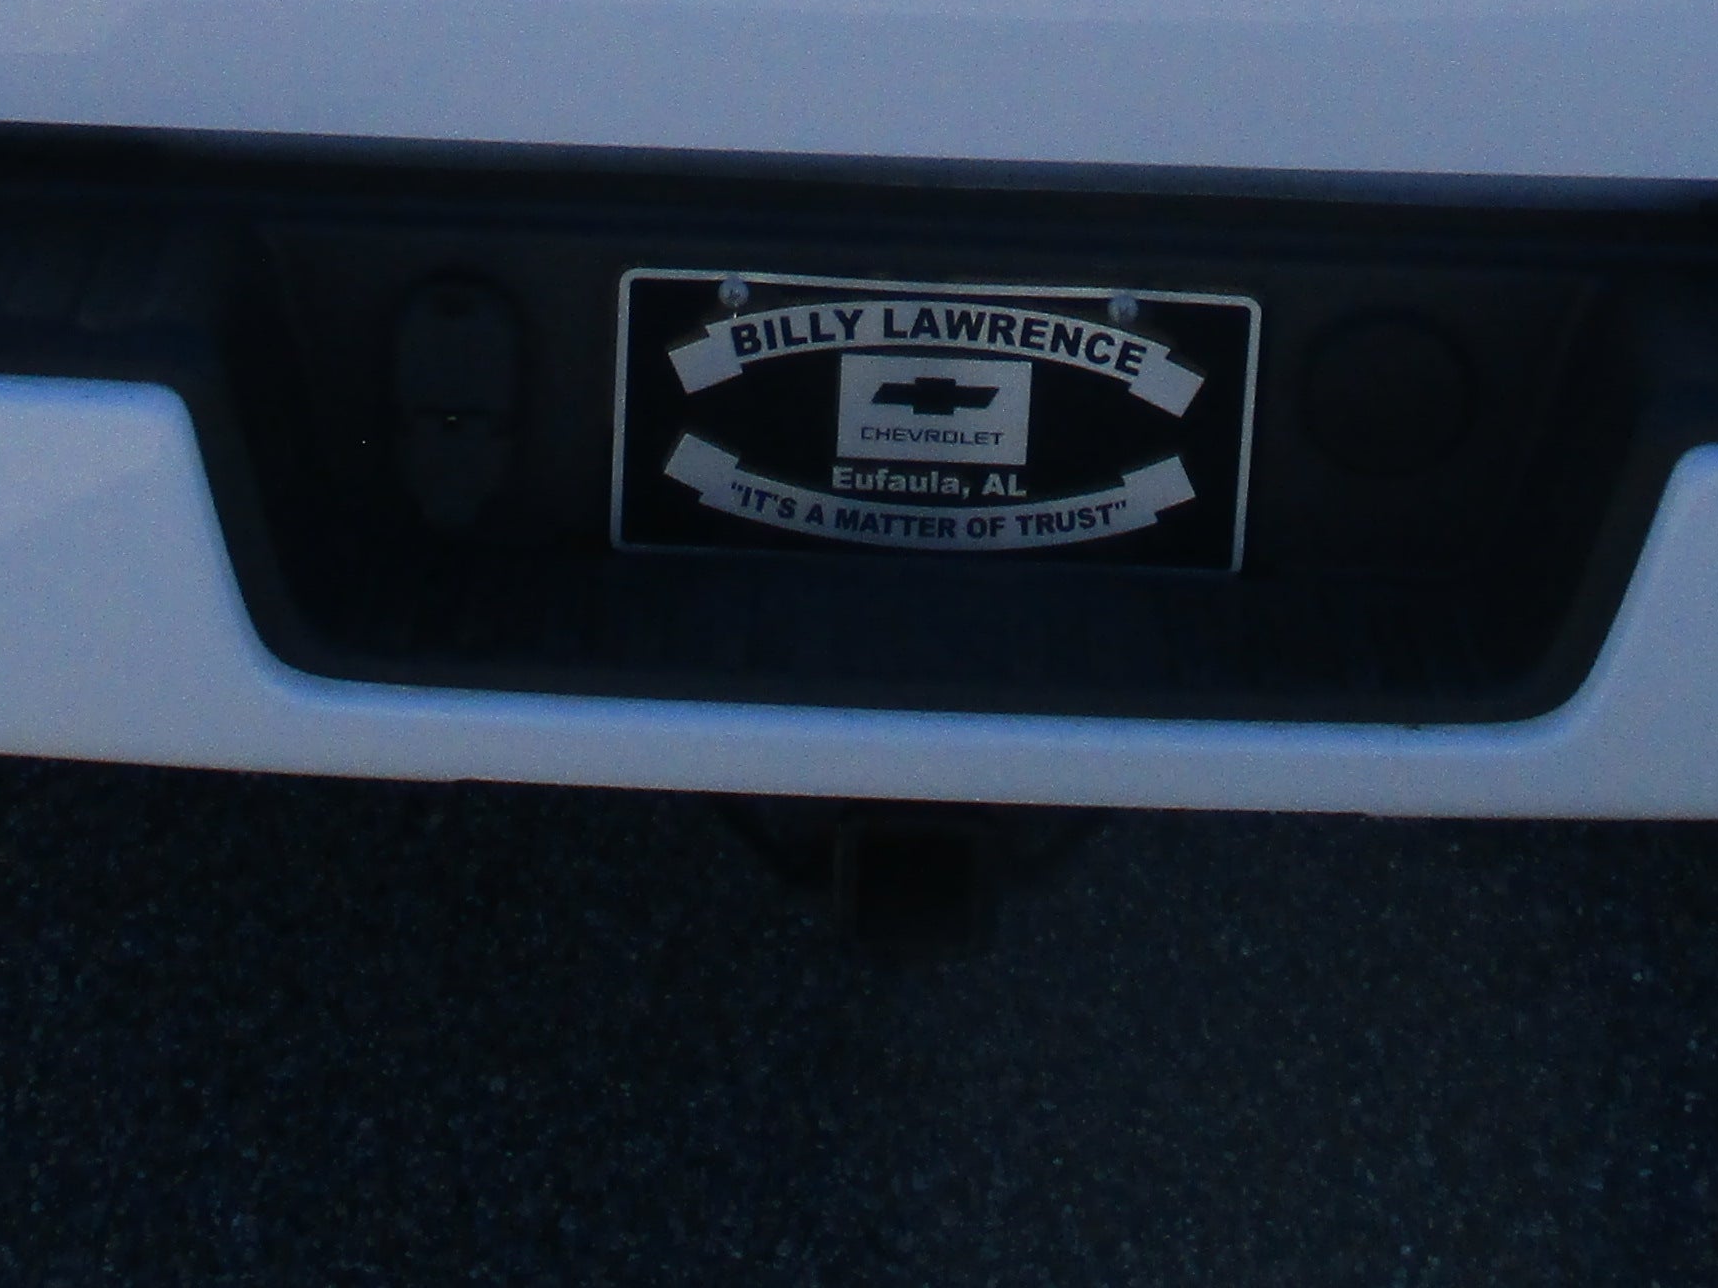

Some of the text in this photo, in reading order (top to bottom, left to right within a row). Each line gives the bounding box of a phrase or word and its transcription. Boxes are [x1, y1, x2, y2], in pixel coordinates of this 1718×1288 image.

[731, 307, 1148, 377] BILLY LAWRENCE
[860, 426, 1004, 446] CHEVROLET
[832, 466, 1028, 500] Eufaula, AL
[730, 481, 1127, 540] "IT'S A MATTER OF TRUST"
